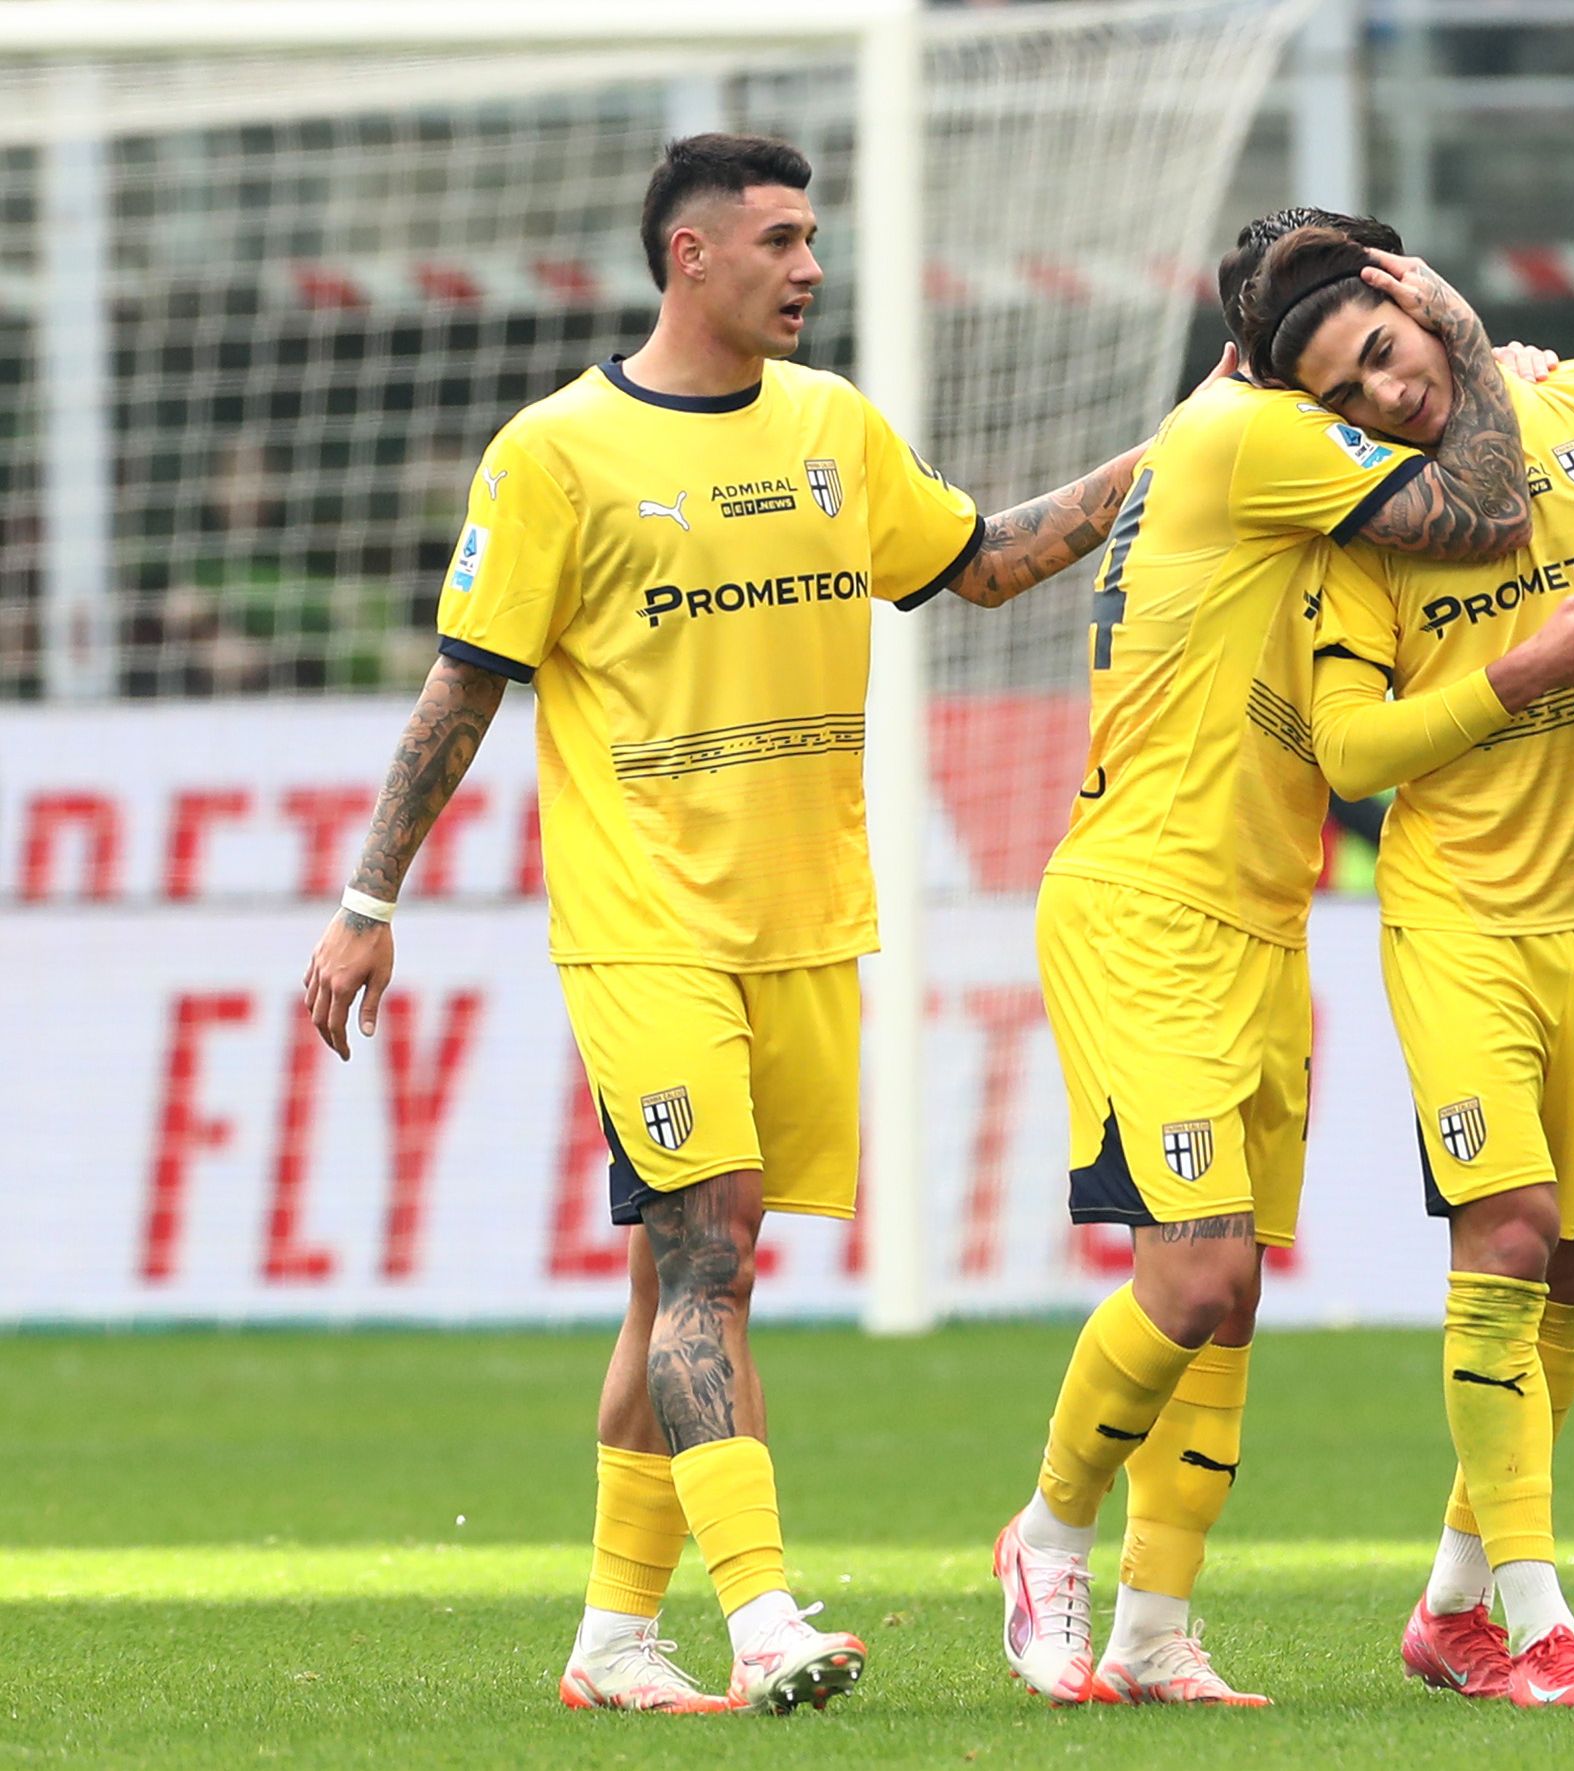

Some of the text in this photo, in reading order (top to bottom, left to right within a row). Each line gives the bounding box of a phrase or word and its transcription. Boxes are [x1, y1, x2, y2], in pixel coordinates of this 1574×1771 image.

[710, 477, 798, 502] ADMIRAL
[637, 571, 869, 628] PROMETEON
[137, 988, 484, 1282] FLY
